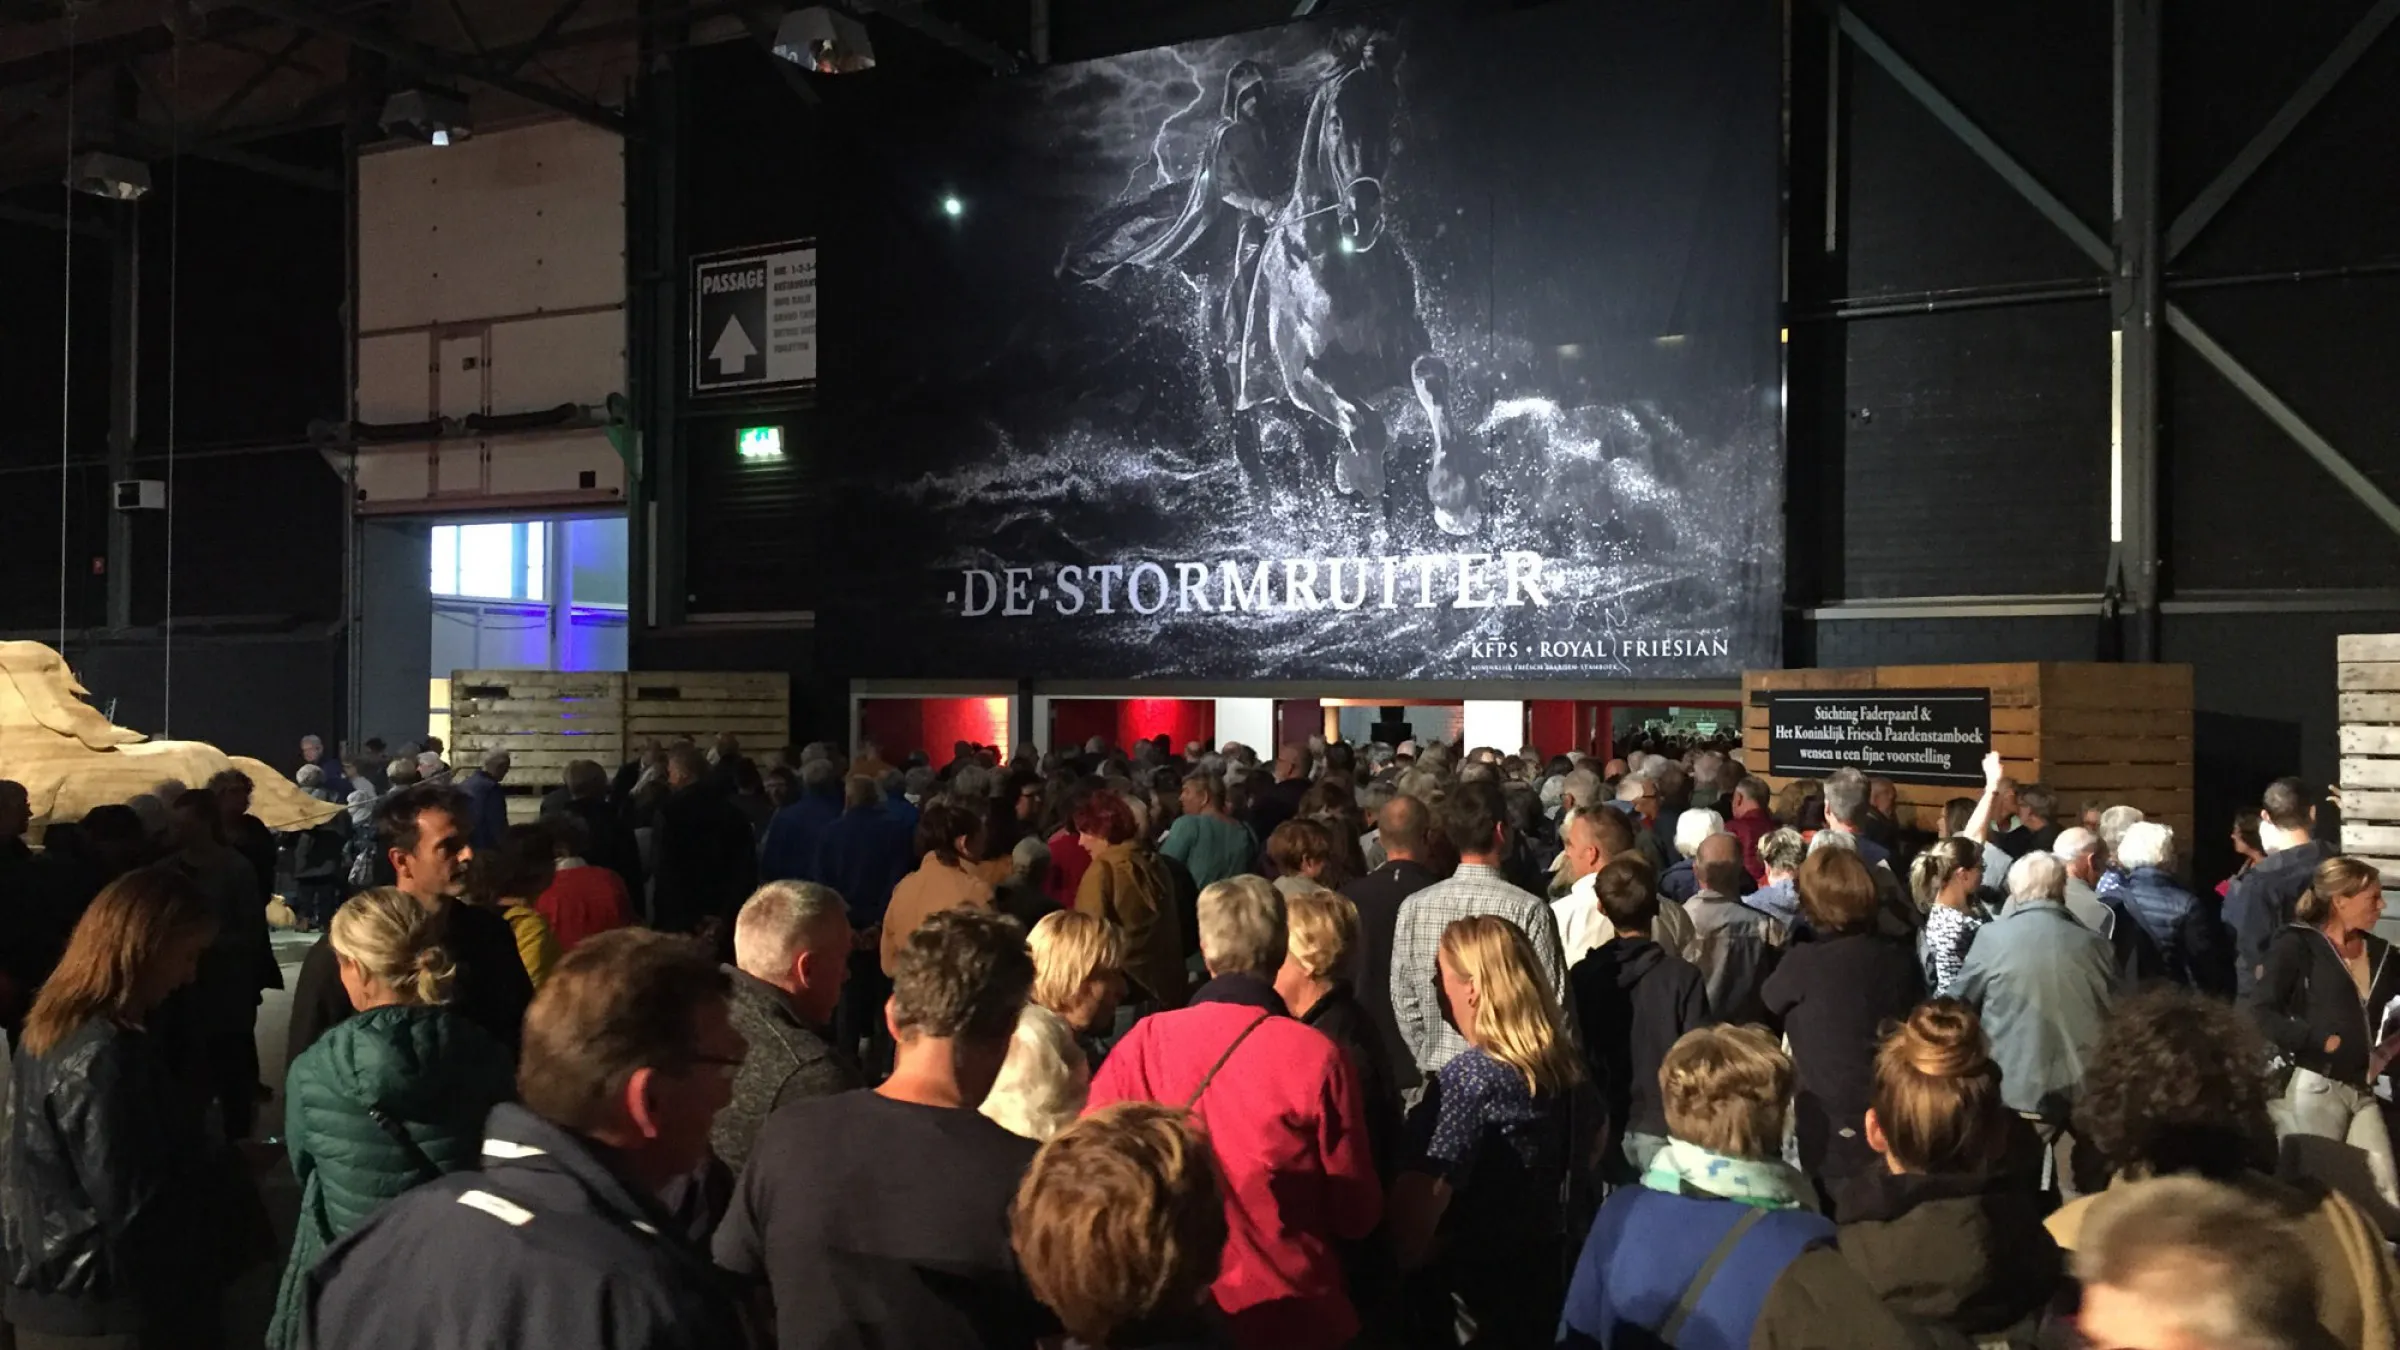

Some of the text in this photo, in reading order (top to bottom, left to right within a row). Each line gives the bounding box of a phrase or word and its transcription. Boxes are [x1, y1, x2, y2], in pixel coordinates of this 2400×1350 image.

[702, 268, 765, 295] PASSAGE
[961, 549, 1550, 618] DE STORMRUITER
[1472, 638, 1729, 658] KFPS ROYAL FRIESIAN
[1815, 705, 1932, 725] Stichting Faderpaard &
[1775, 725, 1984, 744] Het Koninklijk Friesch Paardenstamboek
[1800, 745, 1951, 769] wensen u een fijne voorstelling
